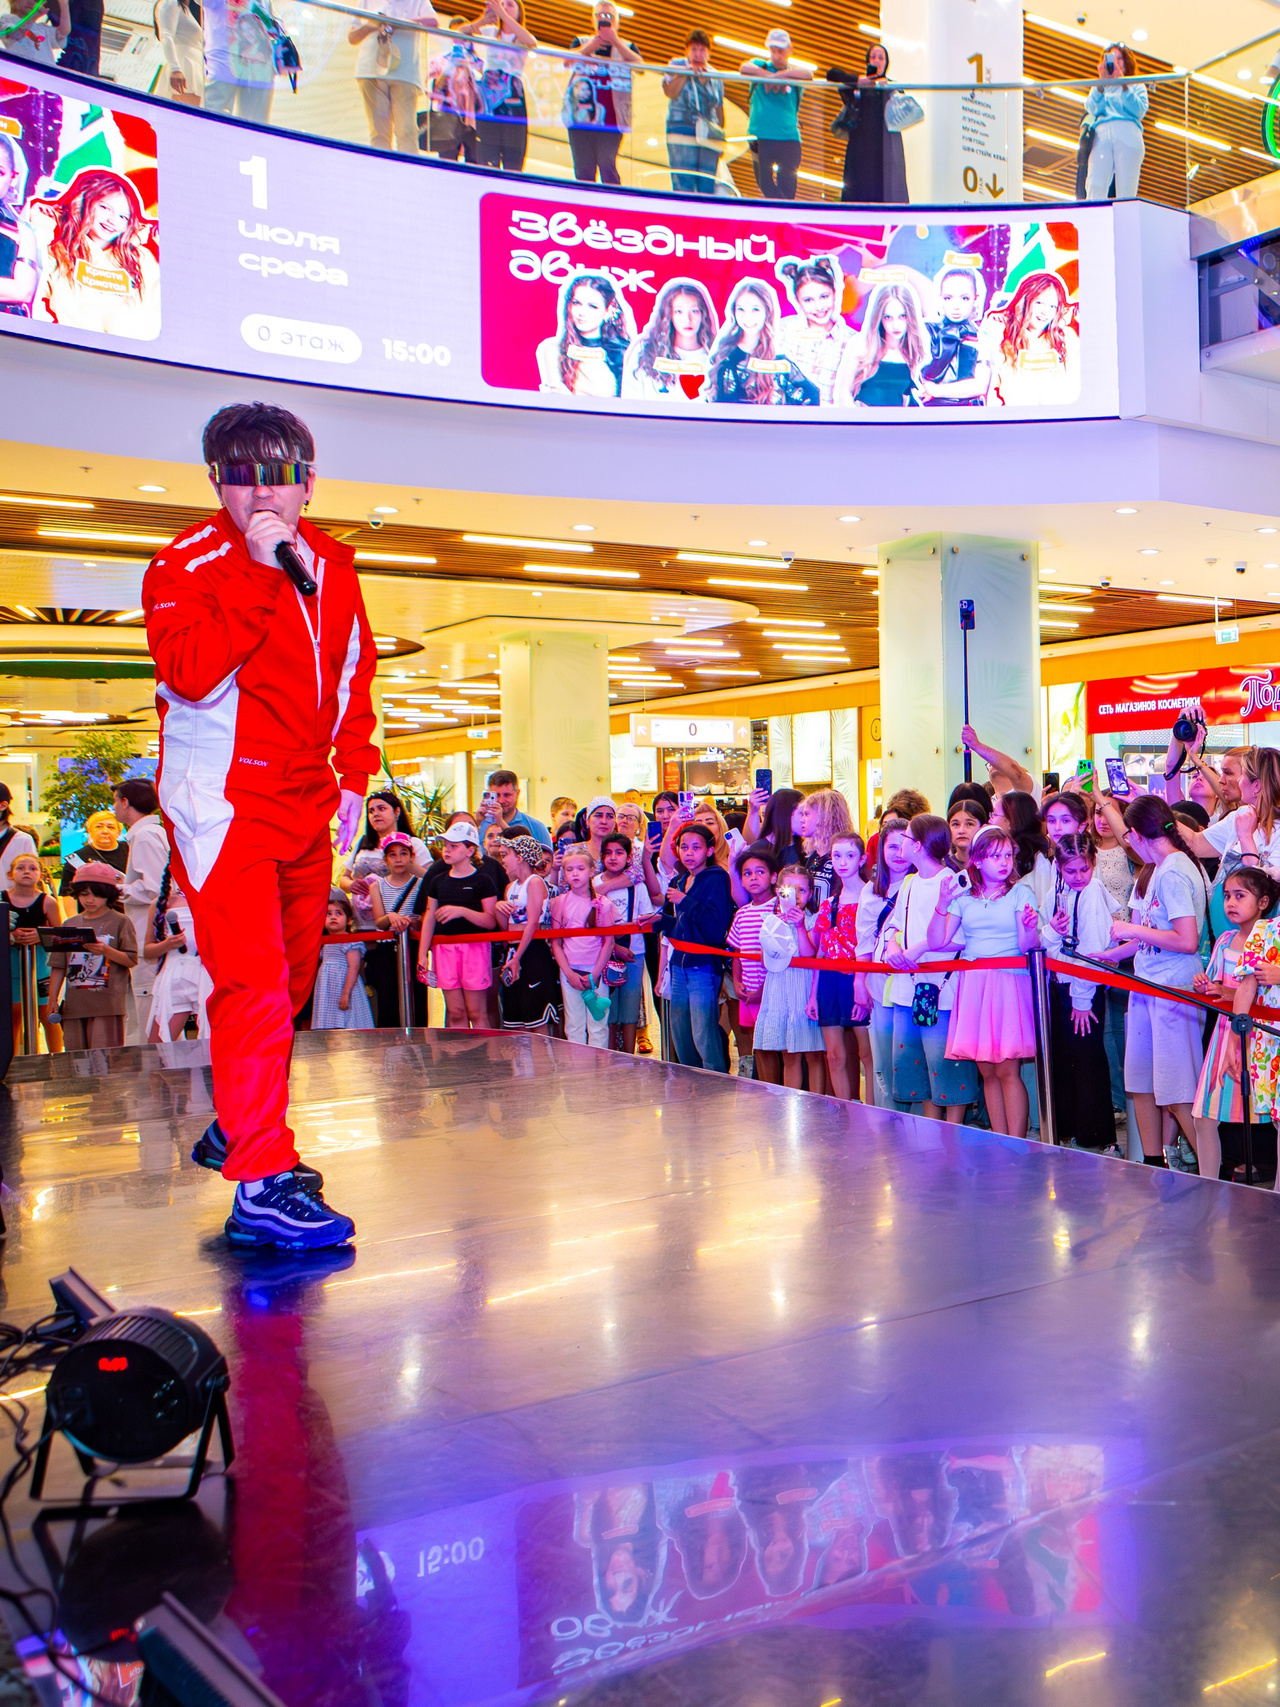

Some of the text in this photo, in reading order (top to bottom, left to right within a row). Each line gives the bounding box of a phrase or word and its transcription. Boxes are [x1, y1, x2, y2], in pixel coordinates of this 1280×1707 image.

[968, 53, 983, 84] 1
[239, 155, 268, 210] 1
[963, 165, 978, 193] 0
[238, 219, 340, 254] июля
[508, 210, 776, 263] Звёздный
[238, 253, 348, 287] среда
[509, 249, 657, 294] двж
[257, 325, 345, 353] 0 этаж
[381, 338, 451, 367] 15:00
[153, 601, 176, 611] LSON
[1098, 696, 1200, 715] СЕТЬ МАГАЗИНОВ КОСМЕТИКИ
[688, 723, 697, 736] 0
[239, 756, 269, 767] VOLSON
